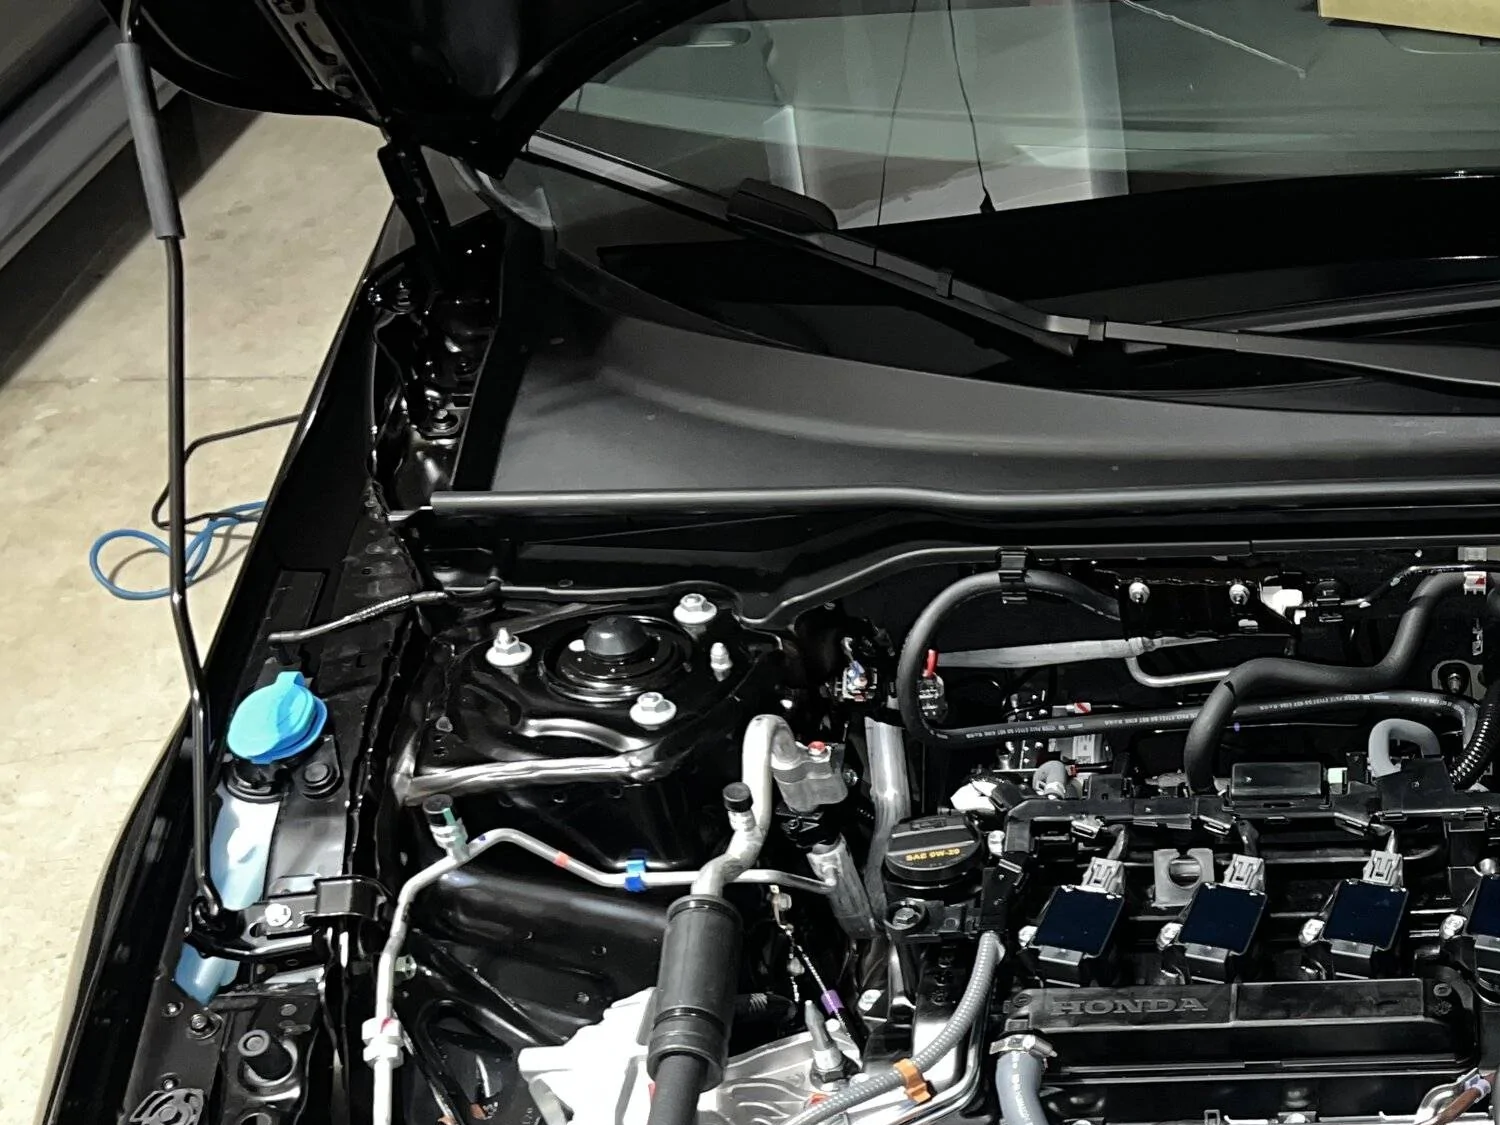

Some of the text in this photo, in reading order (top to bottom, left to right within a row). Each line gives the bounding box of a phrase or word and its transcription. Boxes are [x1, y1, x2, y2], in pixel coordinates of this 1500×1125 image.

[905, 847, 961, 862] SAE 0W-20
[1049, 997, 1209, 1015] HONDA
